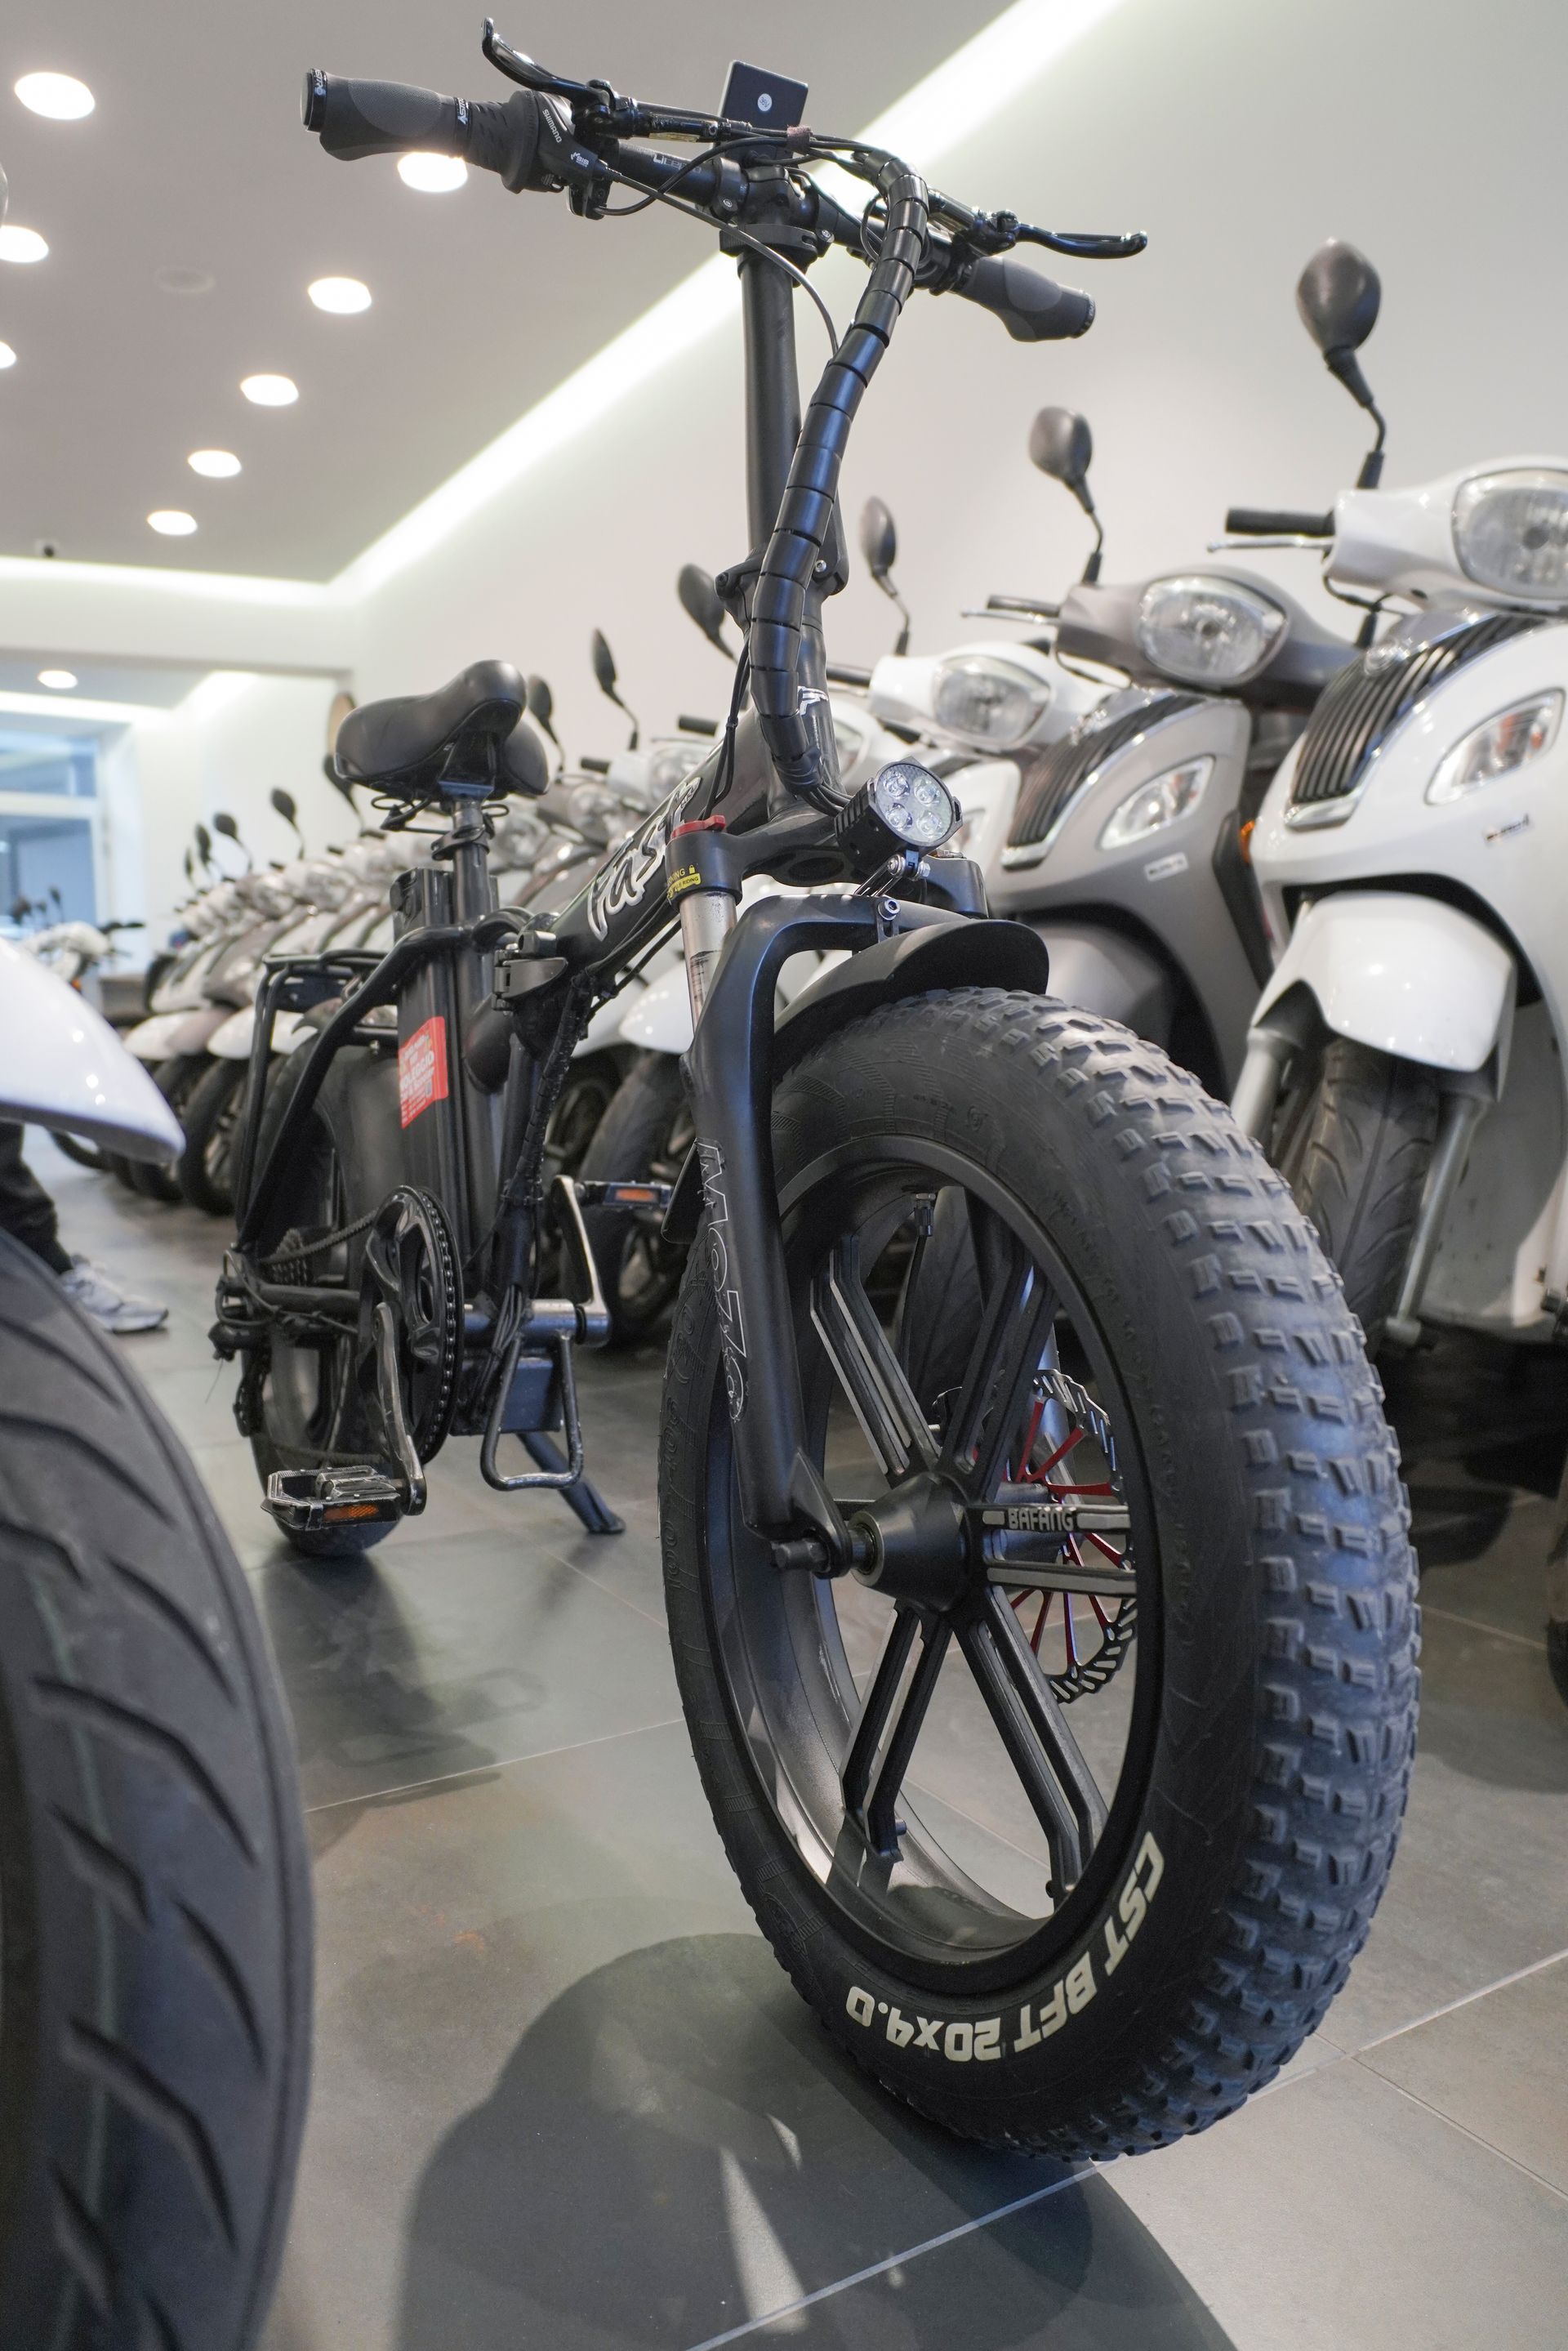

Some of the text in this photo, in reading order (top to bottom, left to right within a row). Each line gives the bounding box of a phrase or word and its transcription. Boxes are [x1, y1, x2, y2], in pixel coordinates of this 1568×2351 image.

[542, 109, 562, 143] SHIMANO
[1008, 1507, 1074, 1532] BAFANG
[846, 1831, 1165, 2062] CST BFT 20x4.0
